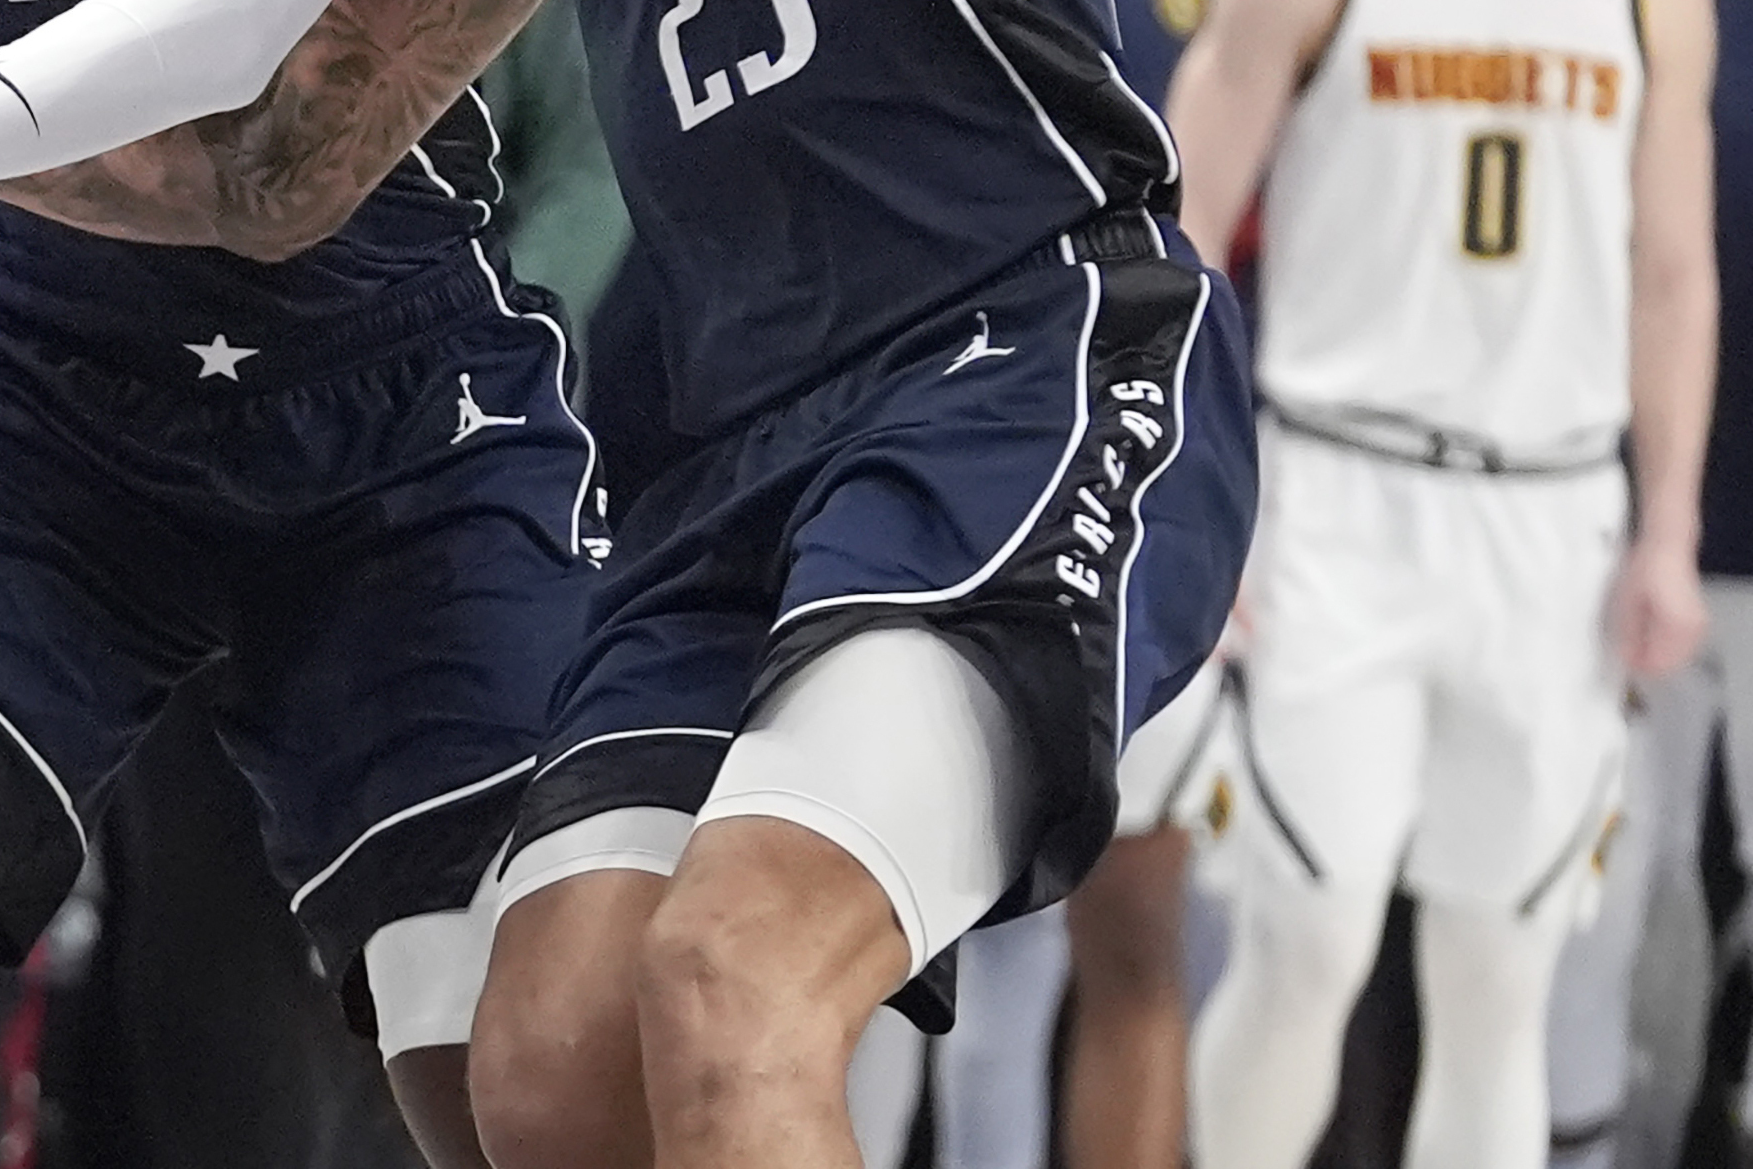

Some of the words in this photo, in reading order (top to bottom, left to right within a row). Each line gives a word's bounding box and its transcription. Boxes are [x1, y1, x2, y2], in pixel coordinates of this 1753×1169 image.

[1368, 50, 1620, 117] NUGGETS
[1463, 136, 1522, 258] 0
[1056, 380, 1165, 599] ERICKS
